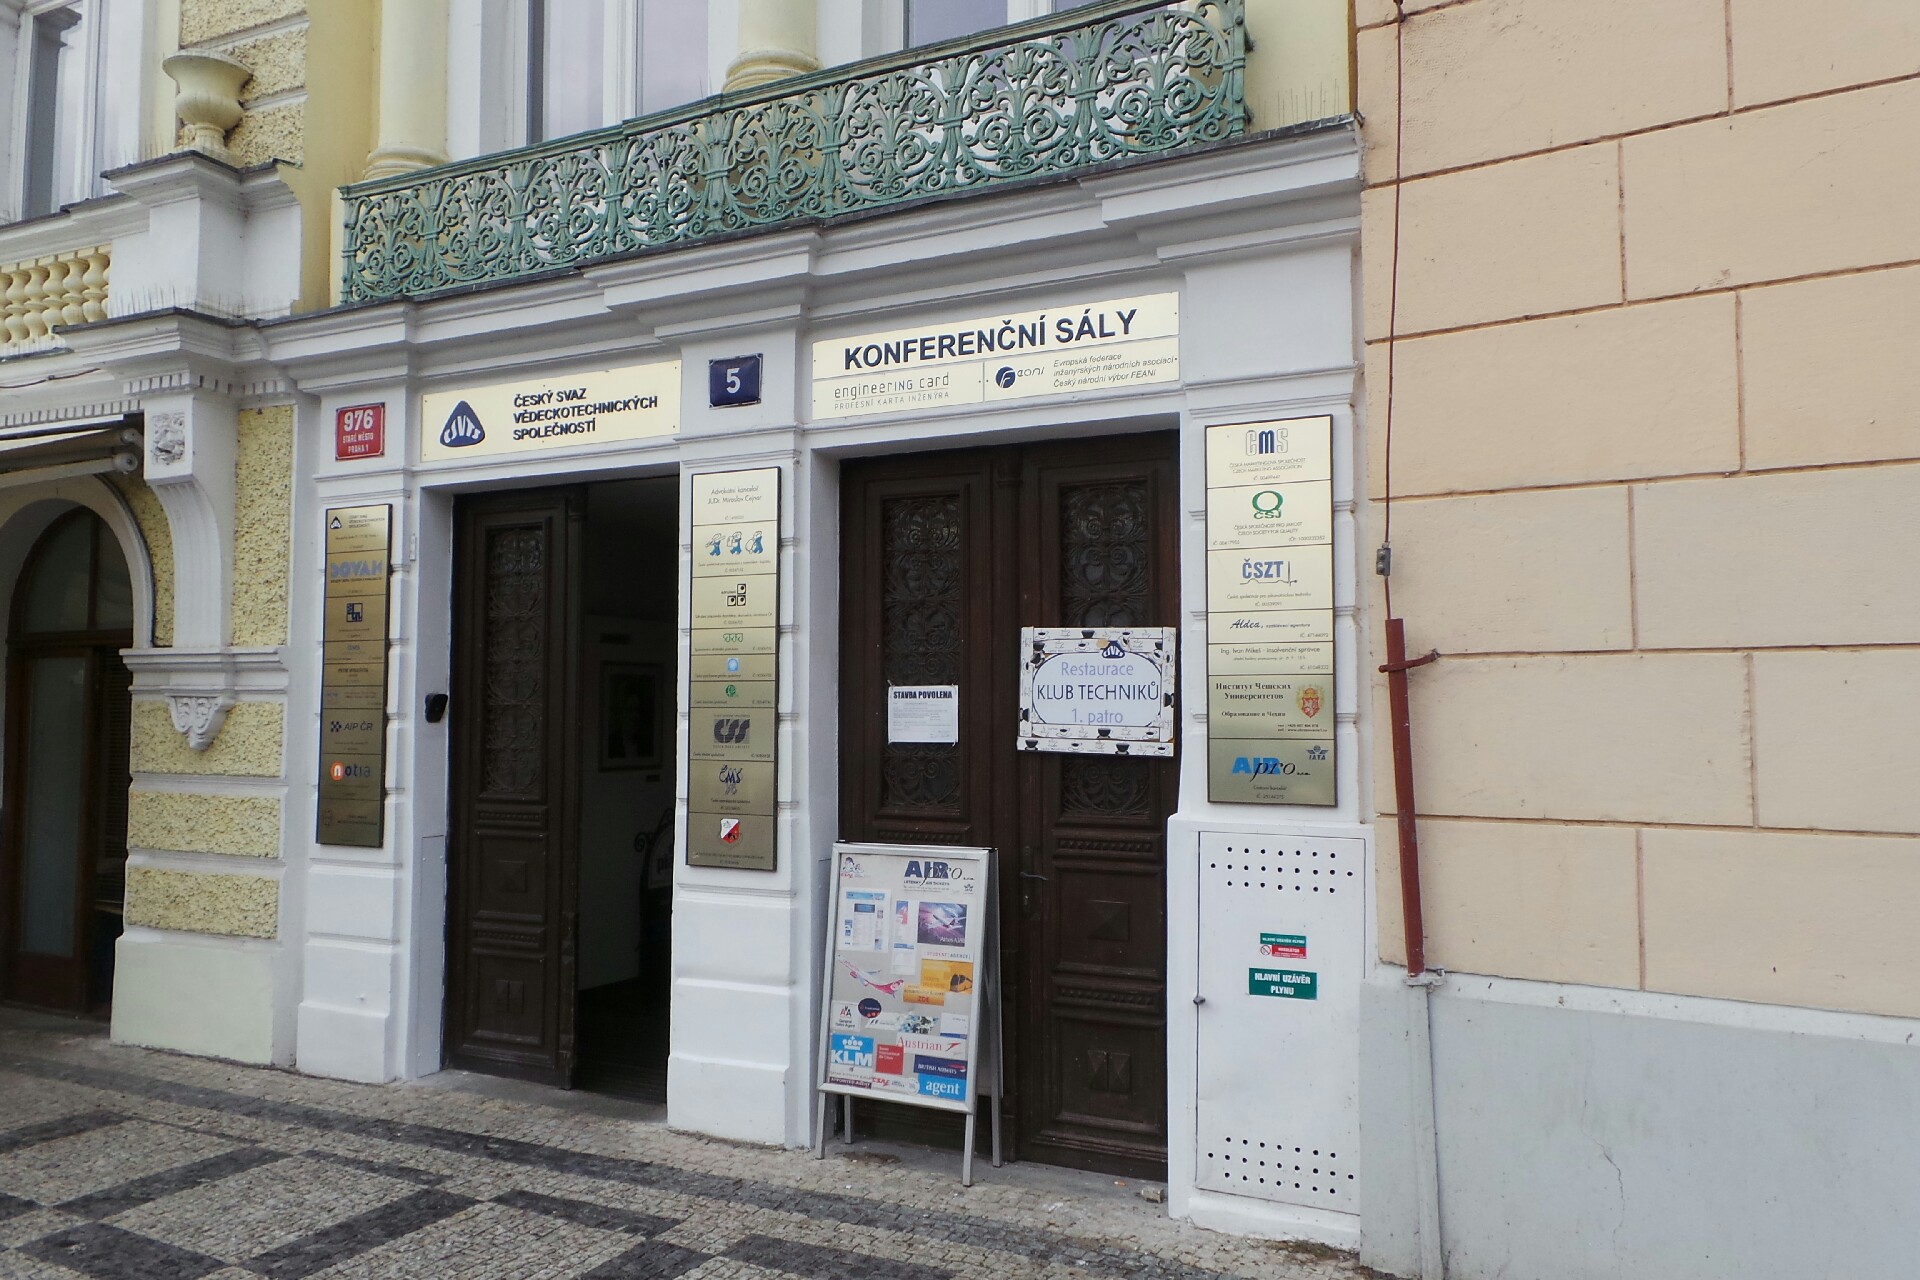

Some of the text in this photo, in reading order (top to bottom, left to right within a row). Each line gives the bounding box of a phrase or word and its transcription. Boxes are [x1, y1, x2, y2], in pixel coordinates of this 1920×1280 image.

[844, 308, 1137, 370] KONFERENČNÍ SÁLY
[1053, 353, 1122, 368] Evropská federace
[726, 368, 741, 394] 5
[919, 372, 949, 389] card
[1053, 378, 1076, 388] Český
[513, 388, 587, 408] ČESKÝ SVAZ
[834, 391, 949, 411] PROFESNÍ KARTA INŽENÝRA
[513, 395, 658, 424] VĚDECKOTECHNICKÝCH
[343, 408, 374, 432] 976
[513, 418, 597, 440] SPOLEČNOSTÍ
[1242, 558, 1284, 579] ČSZT
[1061, 662, 1134, 676] Restaurace
[1037, 681, 1159, 700] KLUB TECHNIKŮ
[1216, 682, 1291, 691] Институт Чешских
[893, 691, 953, 699] STAVBA POVOLENA
[1224, 692, 1284, 701] Университетов
[1071, 708, 1124, 725] 1. patro
[344, 720, 373, 731] AIP ČR
[1254, 972, 1311, 984] HLAVNÍ UZÁVĚR
[1270, 985, 1295, 995] PLYNU
[896, 1036, 943, 1051] Austrian
[831, 1049, 873, 1067] KLM
[917, 1063, 957, 1075] BRITISH AIRWAYS
[925, 1081, 960, 1095] agent
